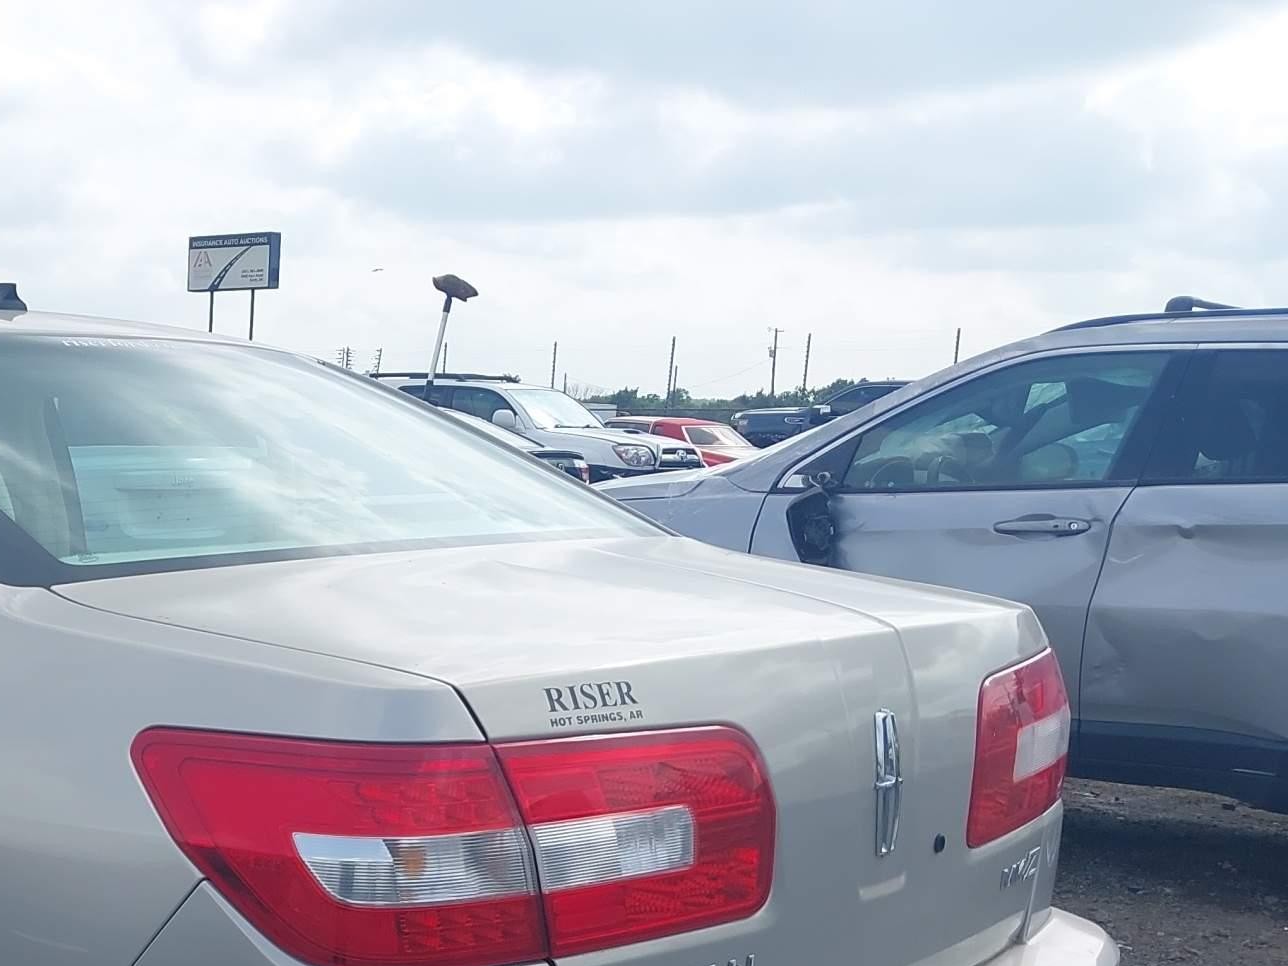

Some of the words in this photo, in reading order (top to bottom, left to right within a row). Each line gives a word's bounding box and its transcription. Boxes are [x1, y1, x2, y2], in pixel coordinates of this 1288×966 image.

[240, 236, 268, 245] AUCTIONS
[543, 681, 638, 713] RISER
[550, 716, 573, 728] HOT
[576, 712, 628, 725] SPRINGS,
[629, 709, 644, 720] AR
